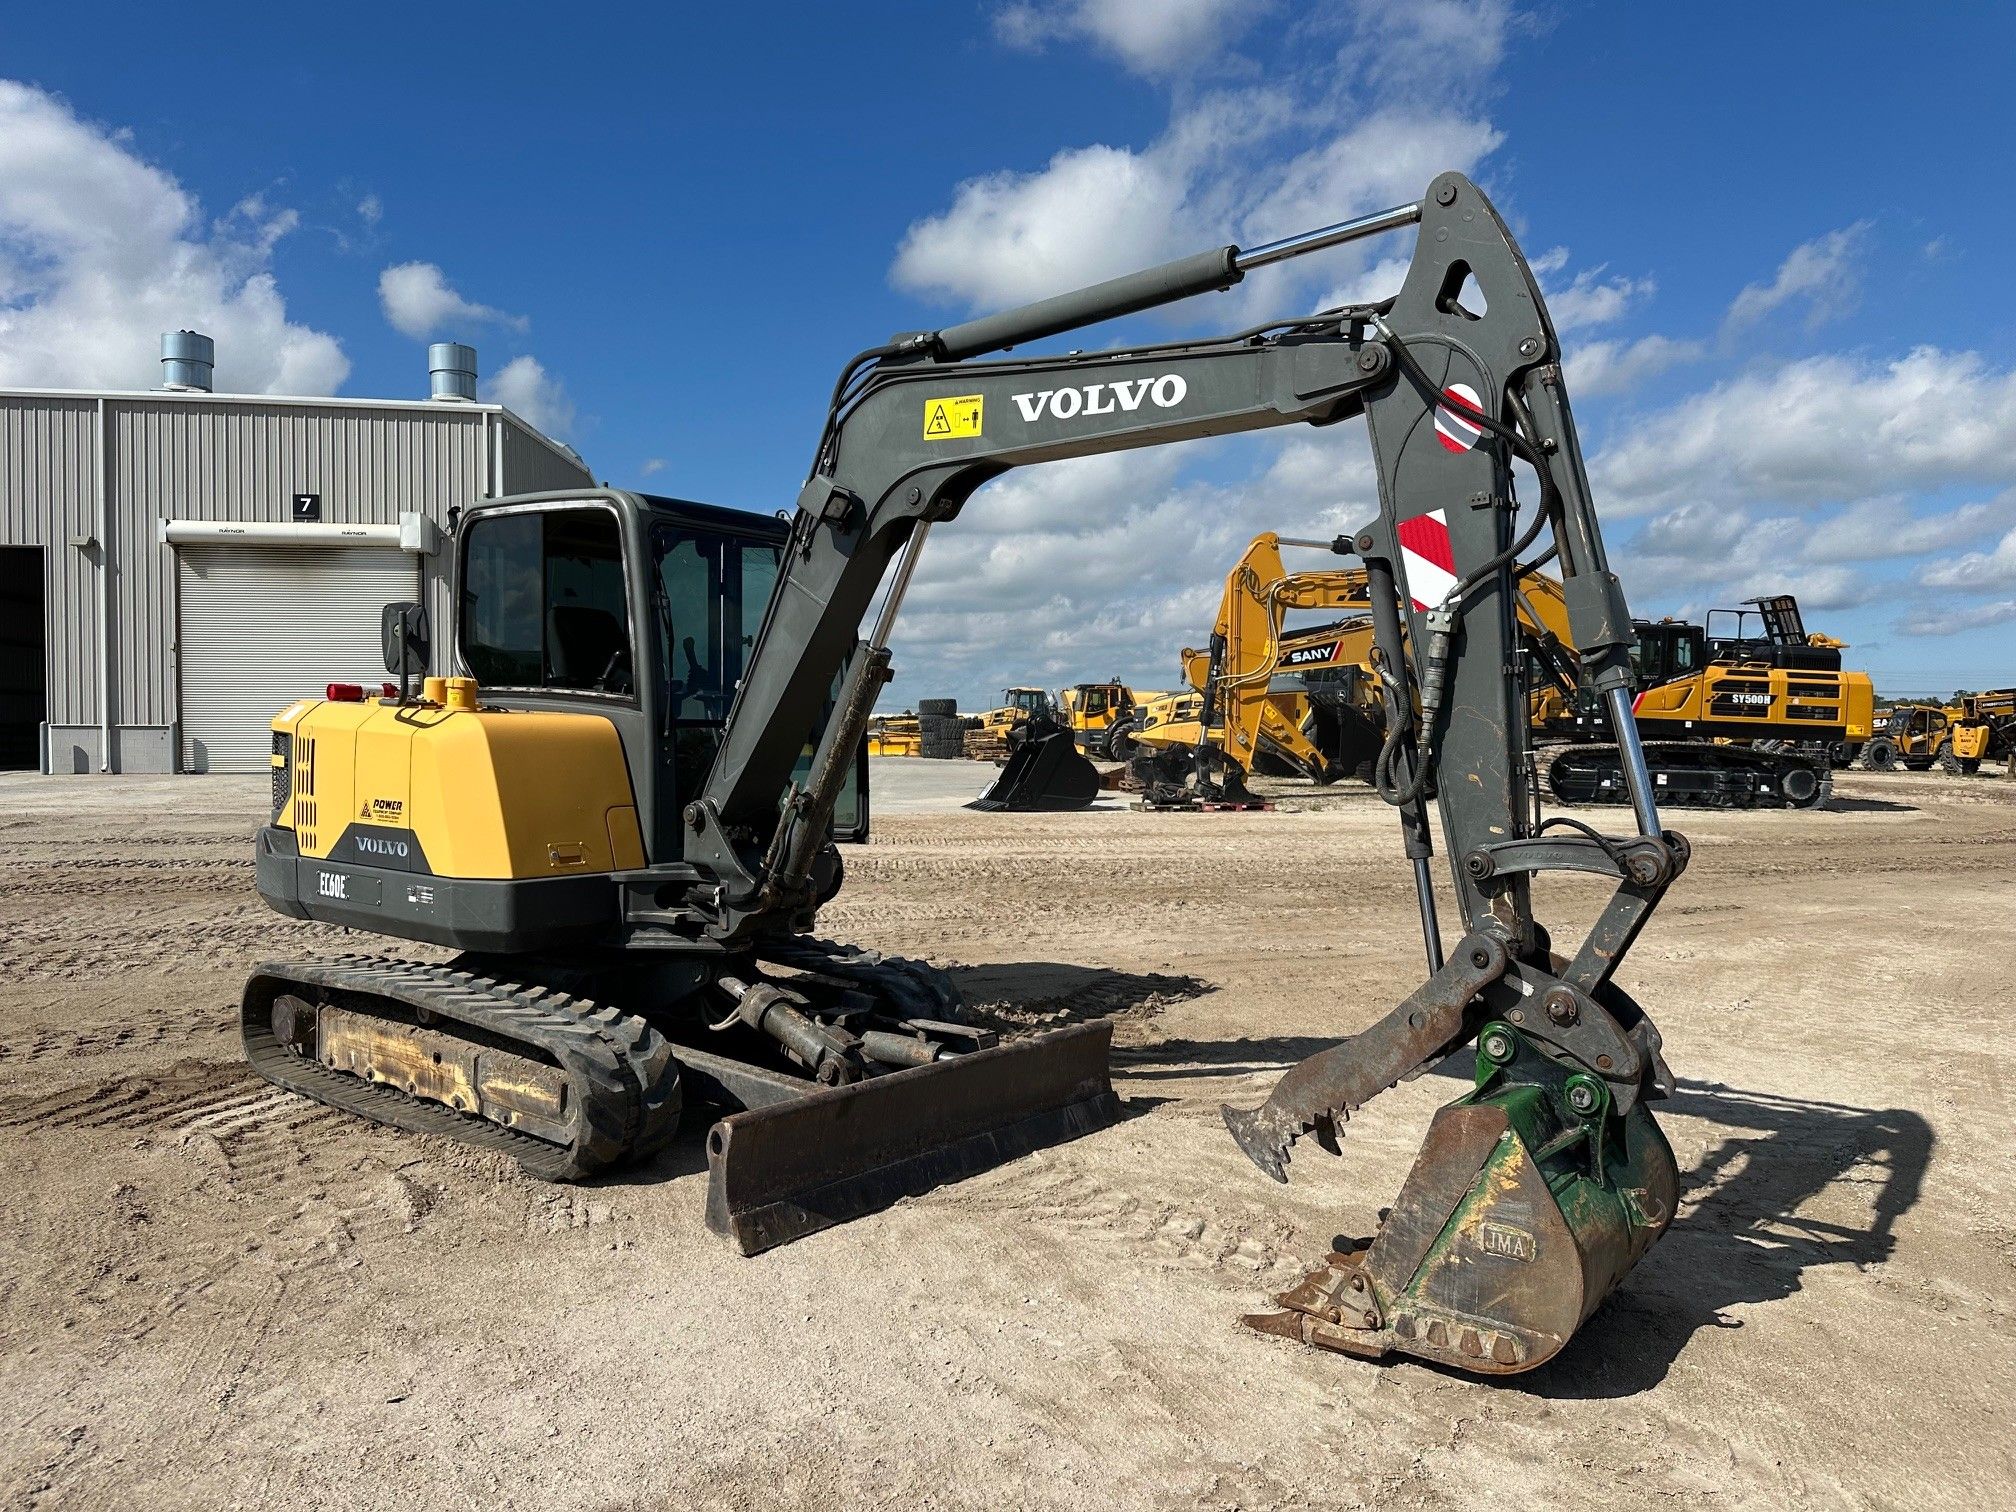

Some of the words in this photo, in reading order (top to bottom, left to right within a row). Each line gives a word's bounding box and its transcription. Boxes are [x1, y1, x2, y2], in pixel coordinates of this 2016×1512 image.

[1011, 374, 1188, 422] VOLVO
[300, 498, 312, 512] 7
[1291, 647, 1332, 663] SANY
[1732, 694, 1771, 705] SY500H
[1872, 718, 1889, 728] SA
[373, 799, 402, 811] POWER
[355, 836, 408, 857] VOLVO
[320, 872, 346, 899] EC60E
[1485, 1231, 1525, 1257] JMA
